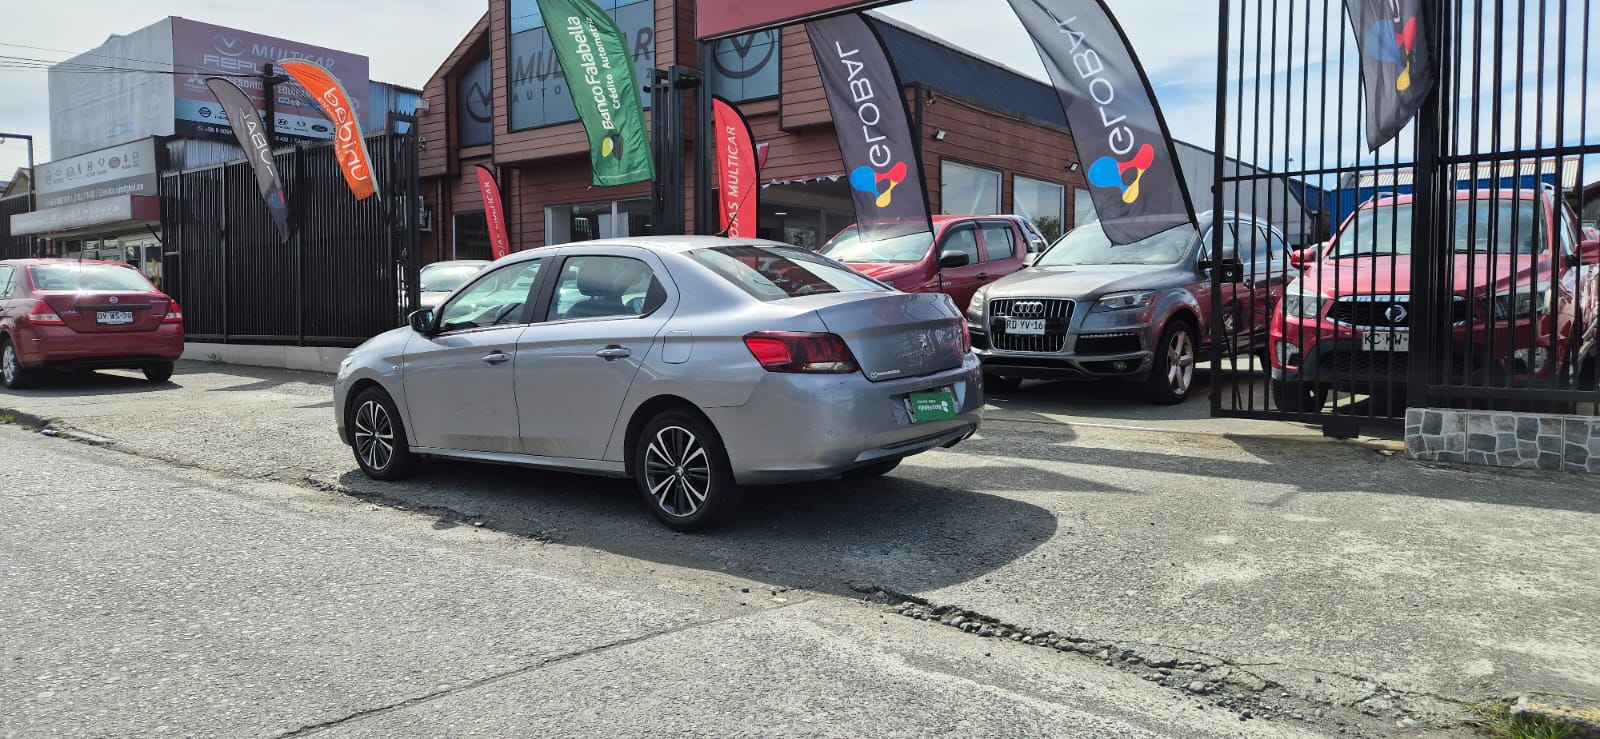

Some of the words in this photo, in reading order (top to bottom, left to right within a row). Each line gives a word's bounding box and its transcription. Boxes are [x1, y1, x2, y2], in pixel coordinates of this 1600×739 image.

[586, 17, 611, 69] Automotriz
[606, 73, 621, 109] Crédito
[727, 126, 739, 198] MULTICAR
